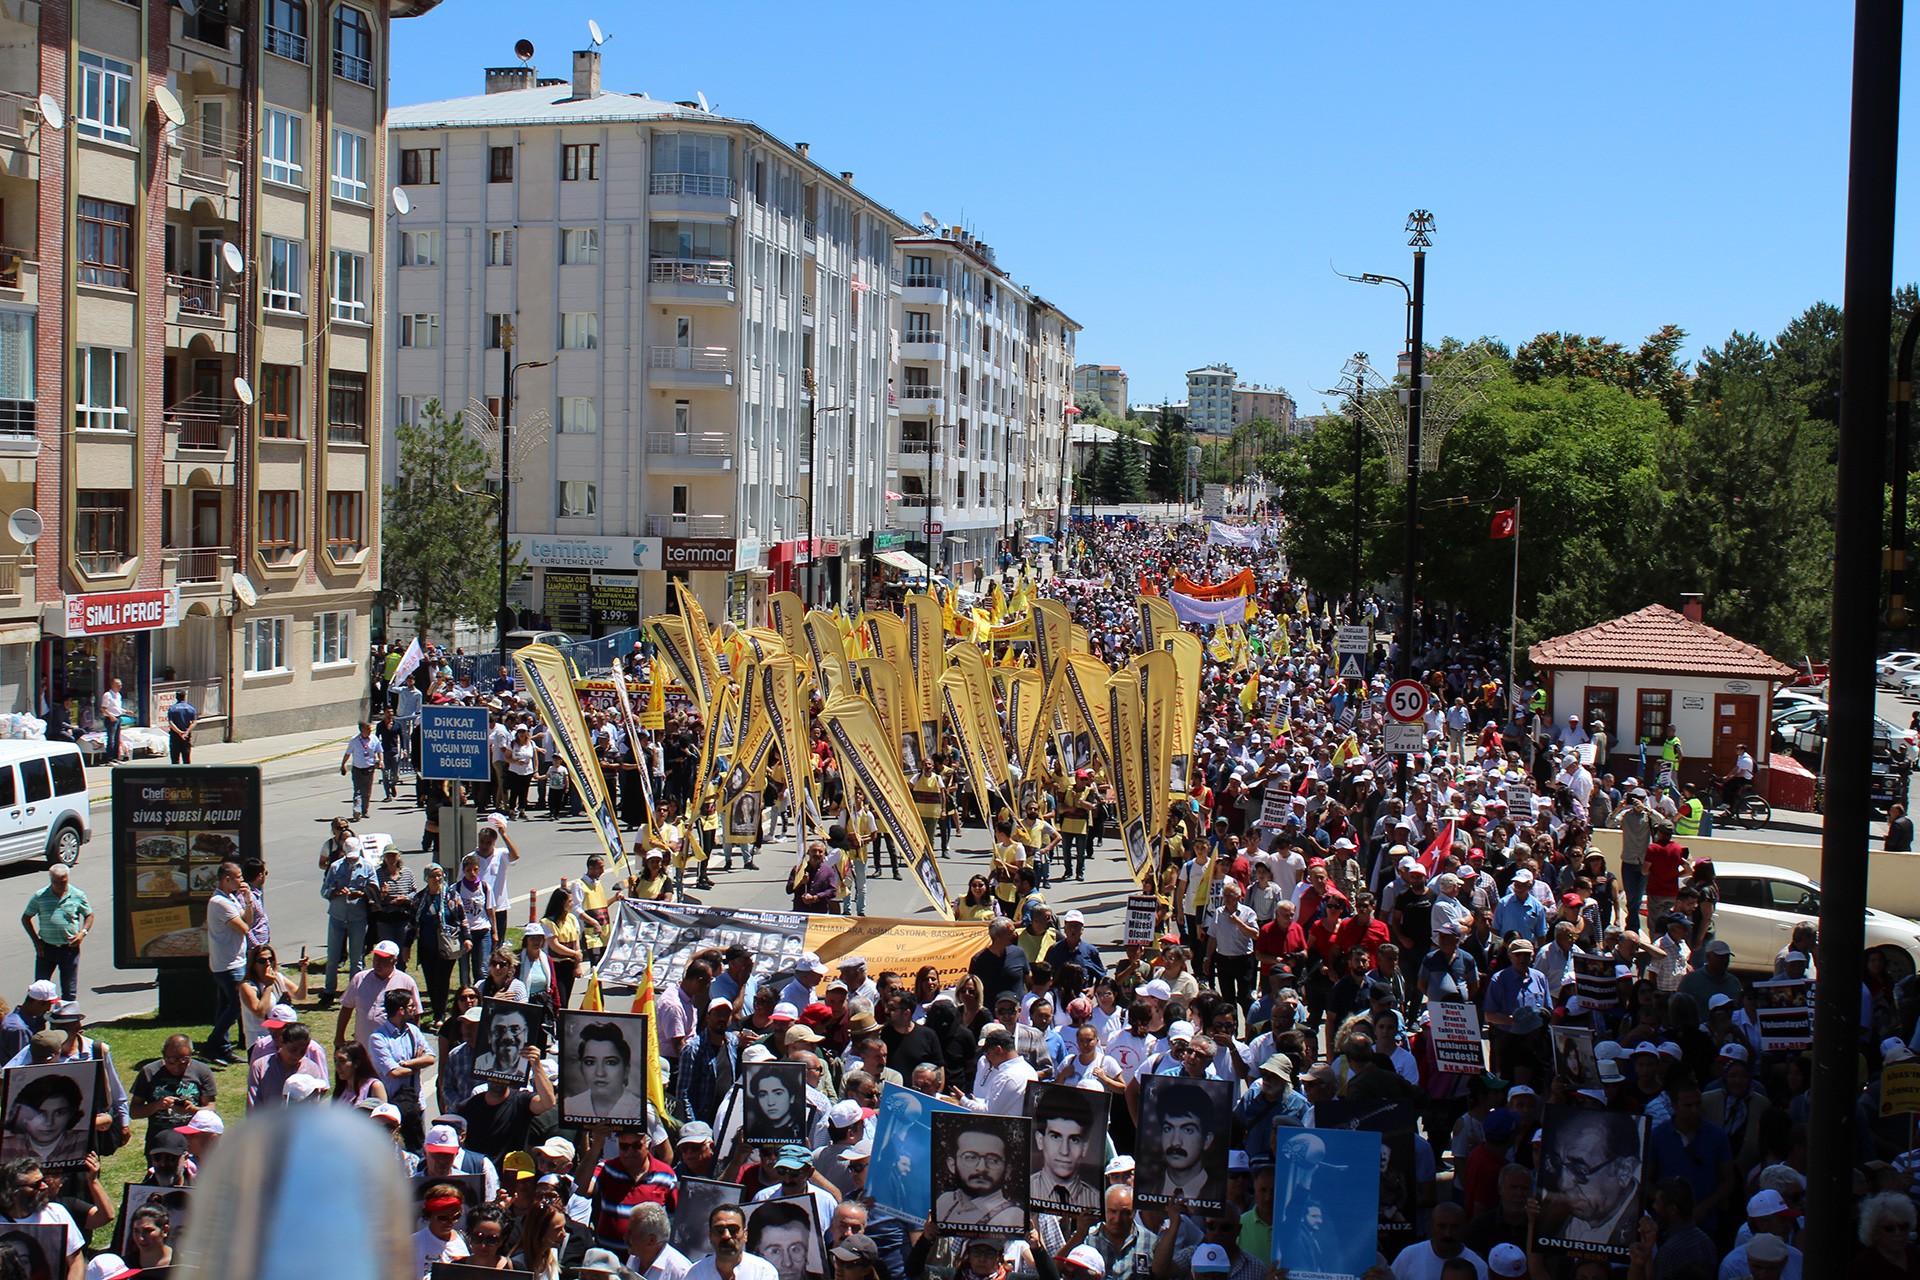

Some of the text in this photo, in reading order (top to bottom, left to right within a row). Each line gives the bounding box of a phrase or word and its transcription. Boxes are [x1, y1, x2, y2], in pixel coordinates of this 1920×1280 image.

[531, 540, 612, 560] temmar
[667, 546, 733, 561] temmar
[546, 582, 587, 592] KAMPANYALAR
[592, 598, 609, 606] HALI
[610, 599, 637, 607] YIKAMA
[123, 601, 163, 624] PERDE
[586, 682, 632, 691] ADALT
[1395, 692, 1420, 711] 50
[434, 717, 475, 728] DİKKAT
[423, 729, 487, 742] YAŞLI VE ENGELLİ
[431, 742, 480, 755] YOĞUN YAYA
[440, 755, 472, 768] BÖLGESİ
[142, 787, 194, 800] ChefBörek
[1267, 801, 1286, 810] Utanç
[133, 808, 242, 826] SİVAS ŞUBESİ AÇILDI!
[1264, 808, 1286, 817] Müzesi
[1264, 815, 1285, 823] Olsun!
[733, 912, 759, 921] Sultan
[760, 911, 777, 922] Ölür
[1131, 911, 1152, 921] Utanç
[1128, 920, 1153, 930] Müzesi
[1128, 929, 1151, 939] Olsun!
[1469, 1043, 1480, 1051] Biz
[1438, 1050, 1479, 1062] Kardeşiz
[485, 1069, 526, 1083] ONURUMUZ
[563, 1115, 642, 1126] ONURMUZ
[41, 1159, 87, 1169] UMUZ
[1137, 1193, 1222, 1209] ONUMUZ
[936, 1222, 1025, 1235] ONURUMUZ
